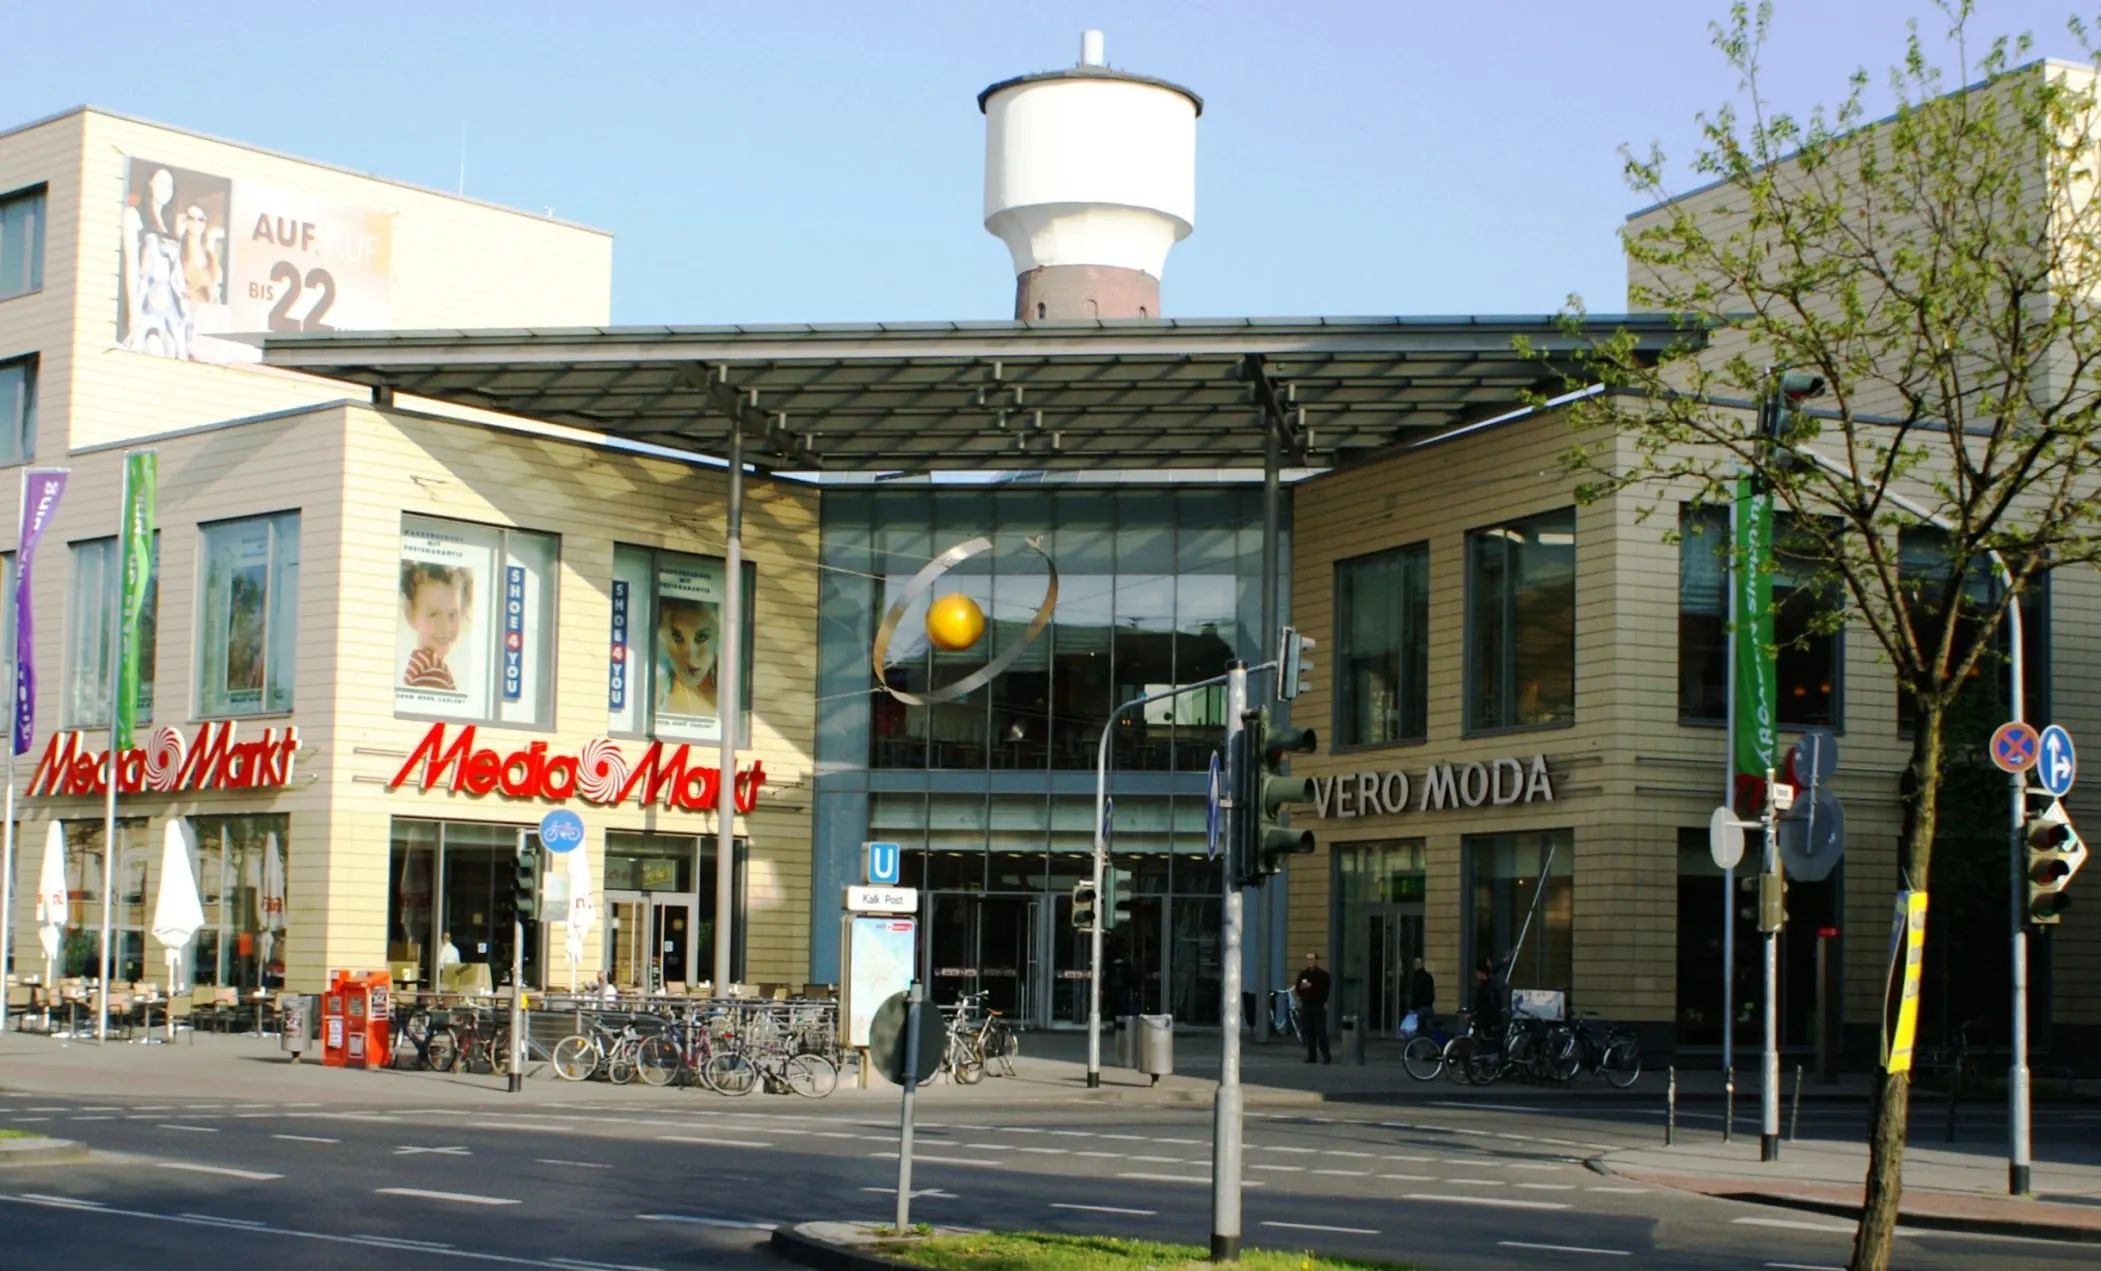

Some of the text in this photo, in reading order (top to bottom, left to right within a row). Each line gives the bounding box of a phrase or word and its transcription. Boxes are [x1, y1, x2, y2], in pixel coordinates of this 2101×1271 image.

[248, 260, 336, 331] BIS 22
[1746, 494, 1766, 614] Shoppng
[26, 720, 303, 797] Media Markt
[388, 721, 767, 814] Media Markt
[1312, 754, 1553, 819] VERO MODA
[862, 893, 903, 904] Kalk Post
[874, 848, 894, 878] U
